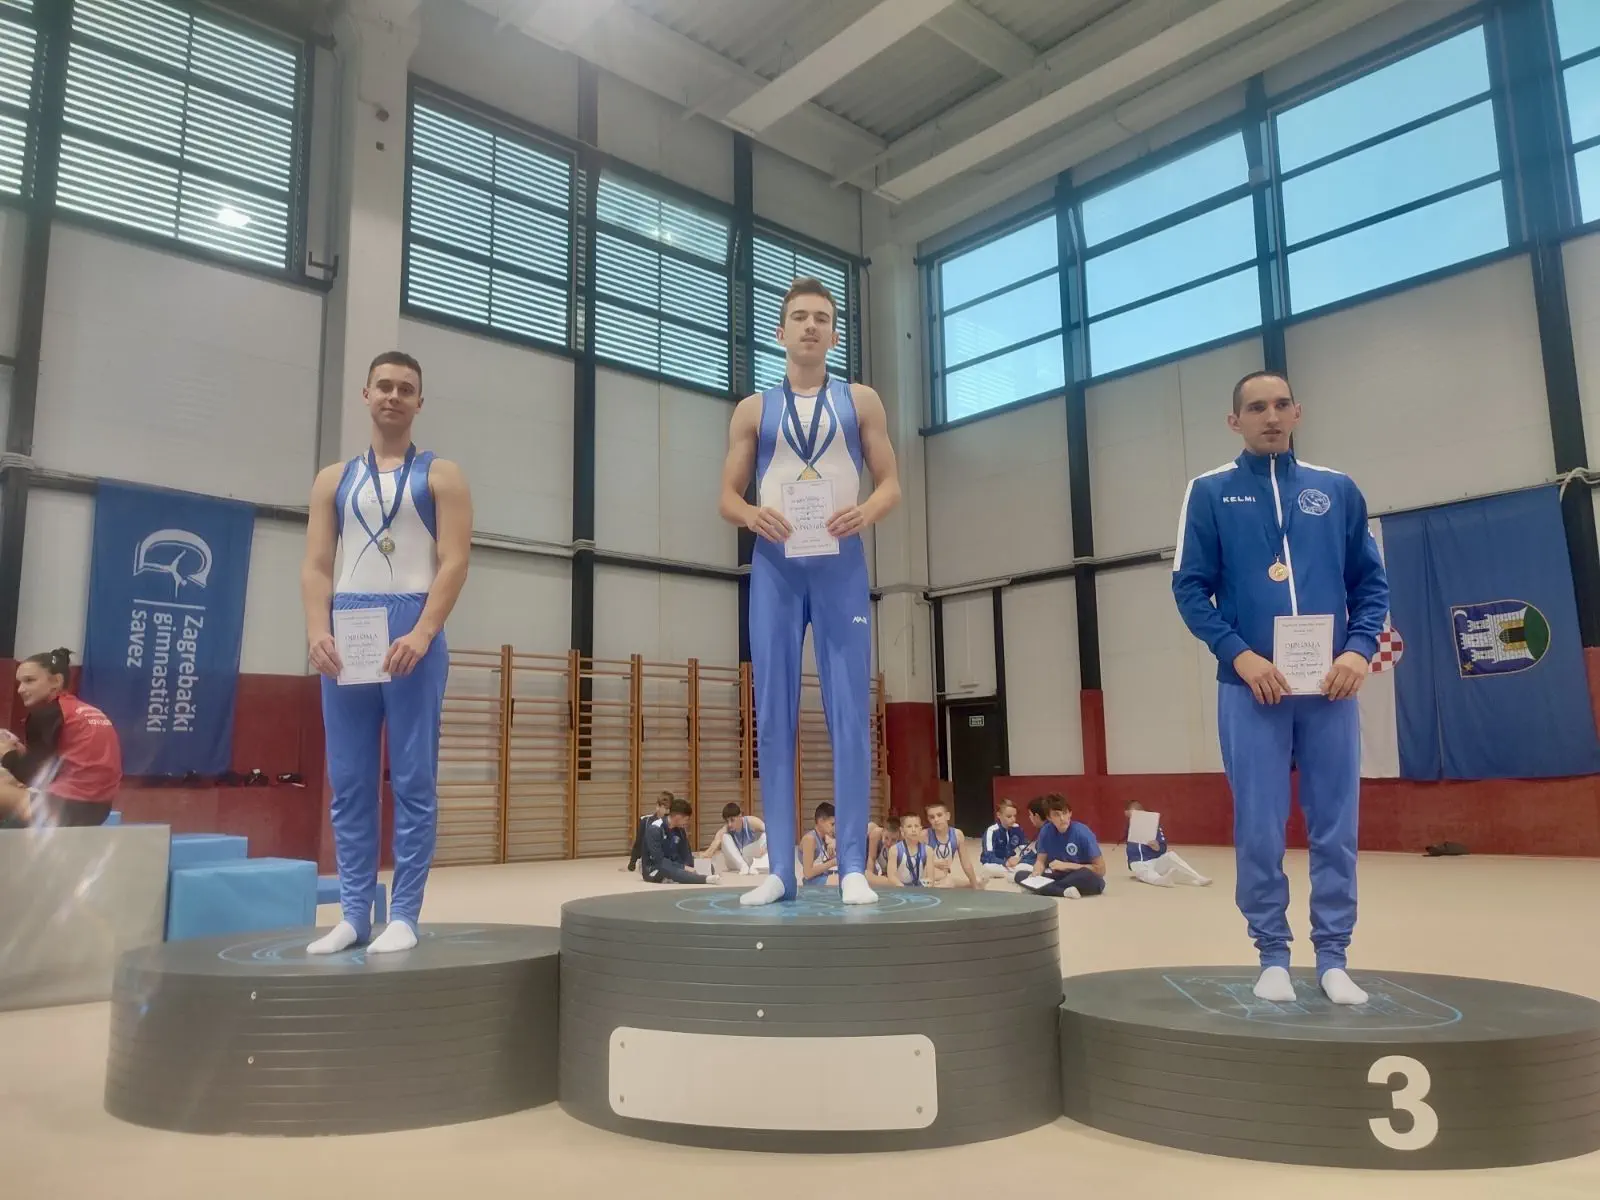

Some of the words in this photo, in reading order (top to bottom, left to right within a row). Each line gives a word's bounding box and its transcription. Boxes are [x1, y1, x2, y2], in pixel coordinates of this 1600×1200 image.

[127, 609, 147, 668] savez
[147, 612, 176, 732] gimnastički
[172, 614, 204, 732] Zagrebački
[1367, 1055, 1439, 1151] 3
